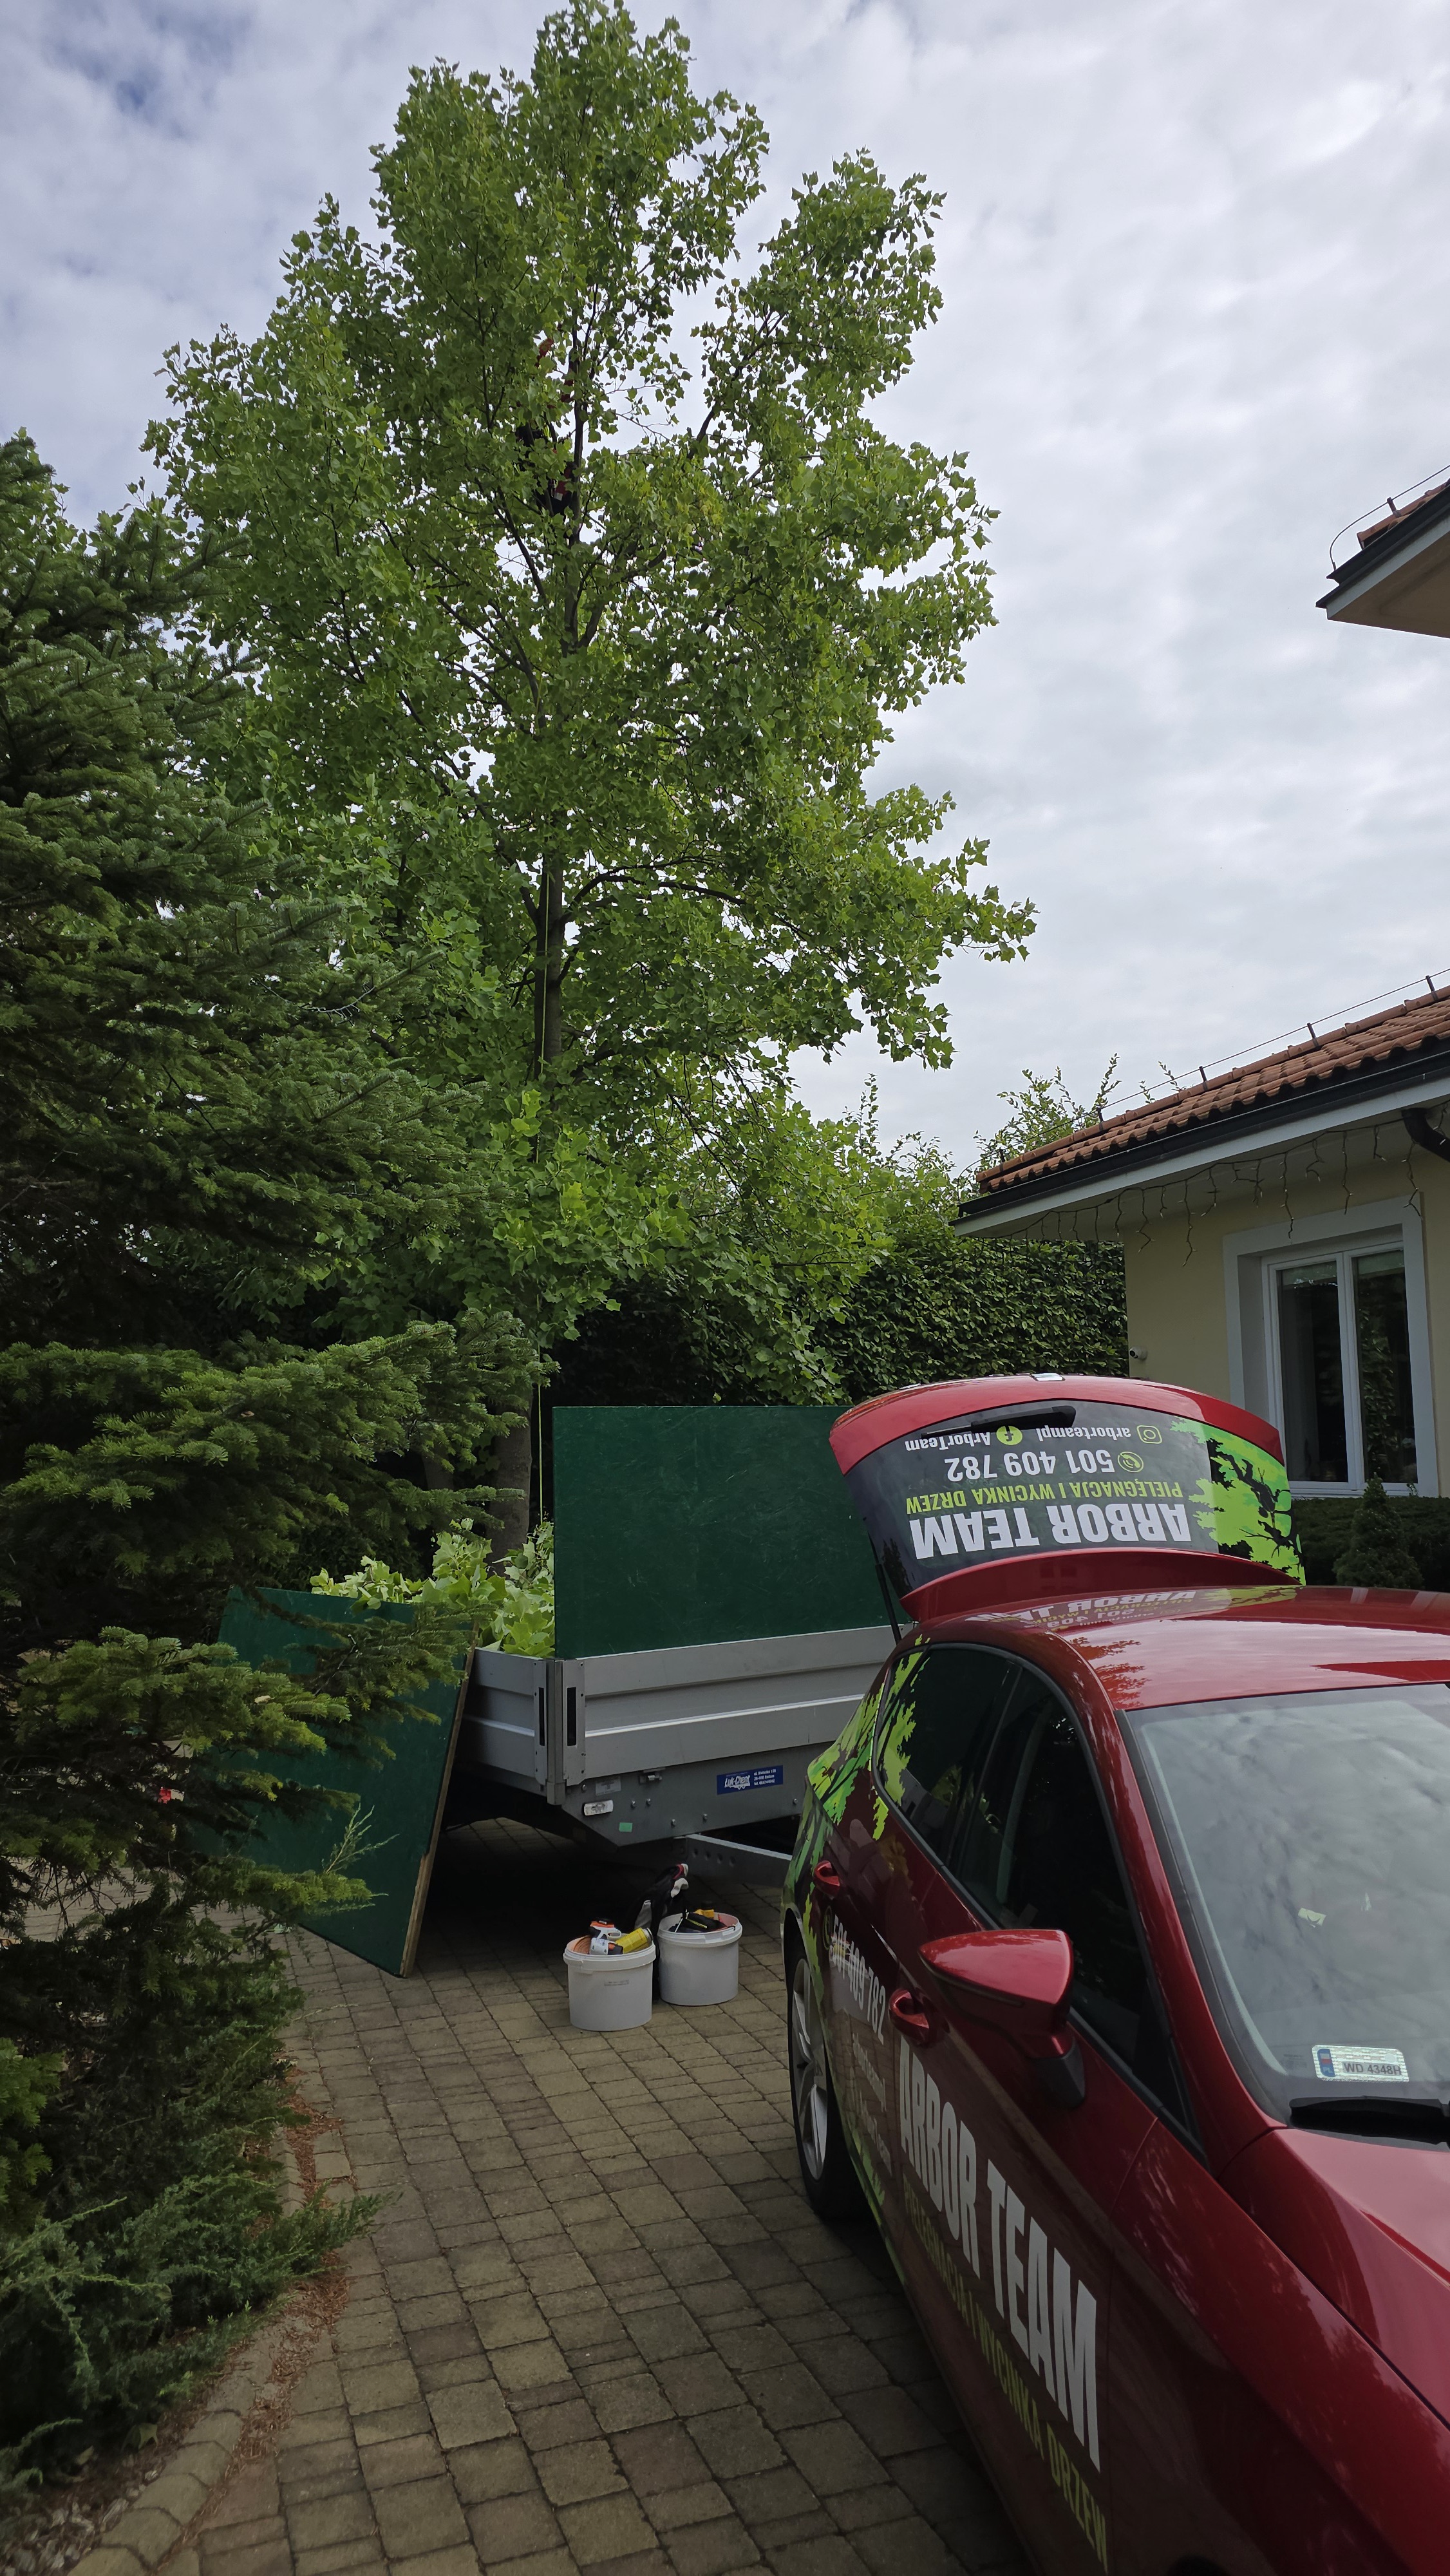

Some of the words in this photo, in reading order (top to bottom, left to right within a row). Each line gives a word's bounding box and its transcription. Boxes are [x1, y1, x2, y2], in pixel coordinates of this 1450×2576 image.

[905, 1432, 991, 1451] ArborTeam
[1035, 1425, 1132, 1442] arborteampl
[944, 1454, 998, 1482] 782
[1003, 1451, 1057, 1476] 409
[1065, 1450, 1115, 1473] 501
[971, 1483, 1056, 1505] WYCINKA
[1058, 1482, 1067, 1499] I
[1068, 1479, 1183, 1498] PIELĘGNACJA
[906, 1490, 967, 1515] DRZEW
[909, 1507, 1040, 1560] TEAM
[1046, 1503, 1192, 1544] ARBOR
[833, 1914, 847, 1980] 501
[847, 1940, 865, 2011] 409
[867, 1966, 886, 2045] 782
[1343, 2063, 1364, 2073] WD
[1367, 2065, 1402, 2076] 4348H
[900, 2034, 981, 2280] ARBOR
[987, 2159, 1100, 2473] TEAM
[975, 2301, 1045, 2461] WYCINKA
[1046, 2421, 1108, 2575] DRZEW
